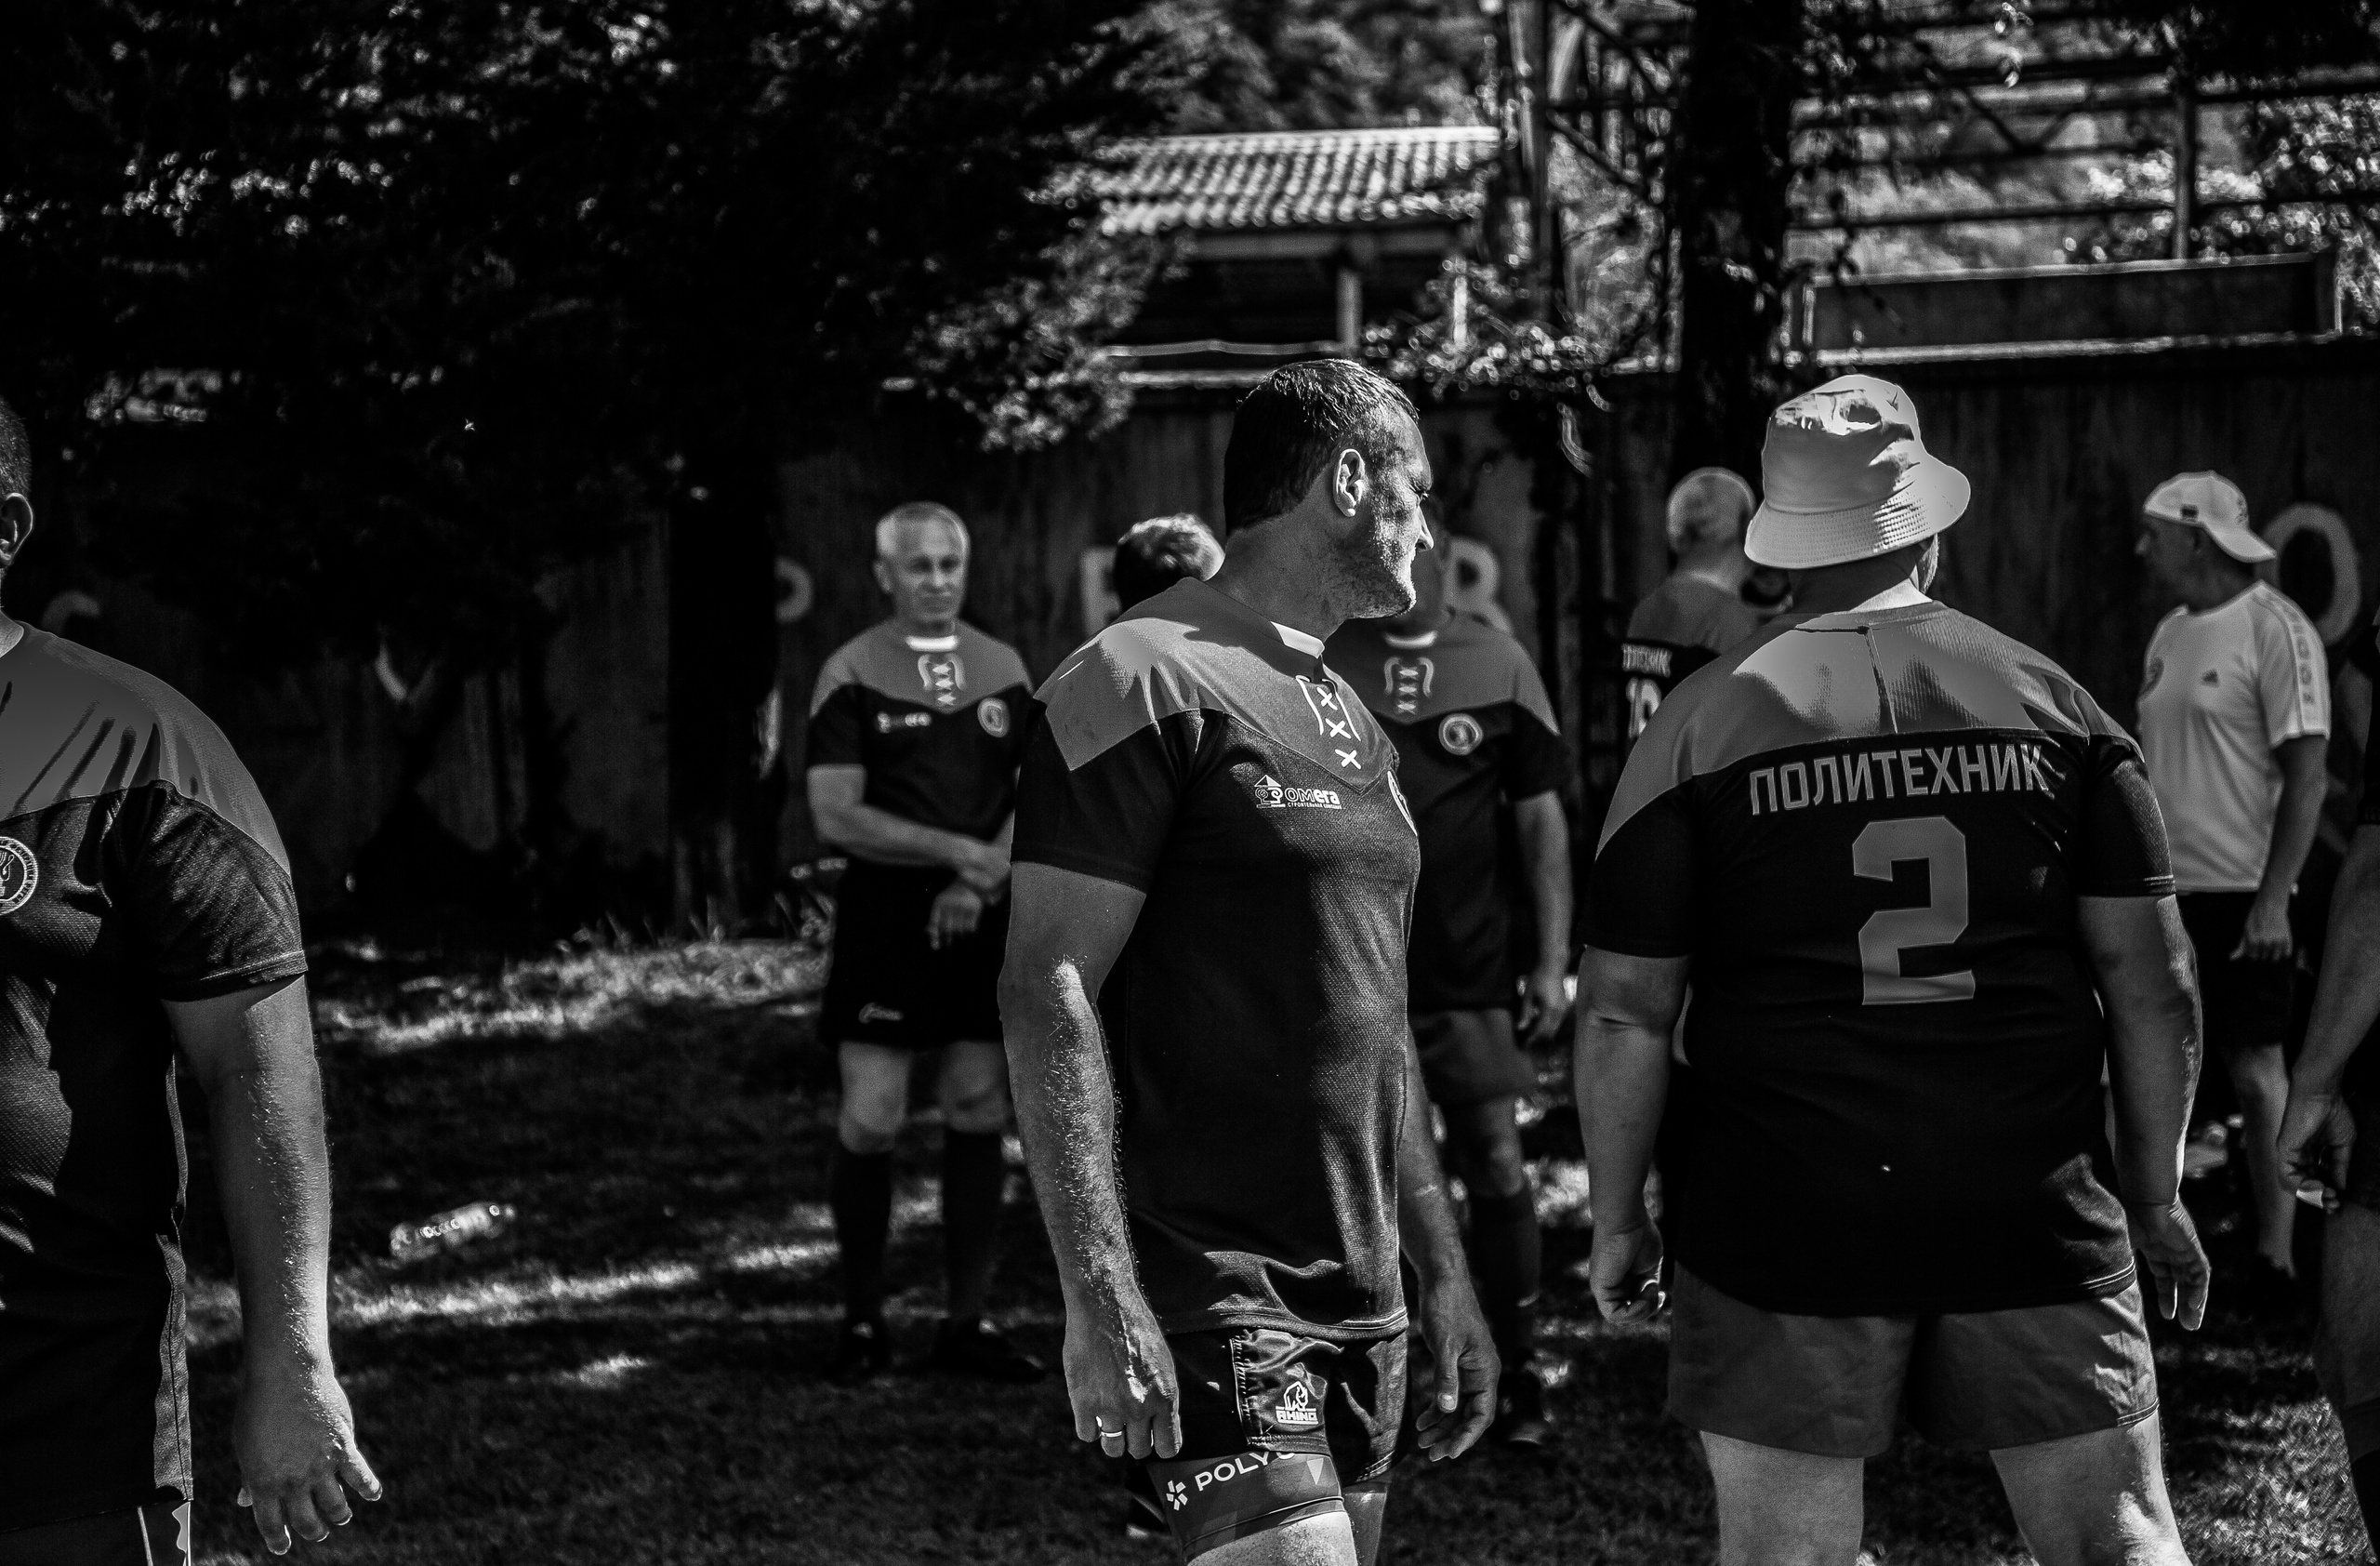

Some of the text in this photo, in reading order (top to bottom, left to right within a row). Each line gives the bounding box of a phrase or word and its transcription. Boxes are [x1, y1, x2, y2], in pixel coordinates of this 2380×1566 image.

[1749, 743, 2050, 816] ПОЛИТЕХНИК
[1852, 816, 1977, 1006] 2
[1276, 1410, 1318, 1421] RHINO
[1194, 1451, 1296, 1492] POLY
